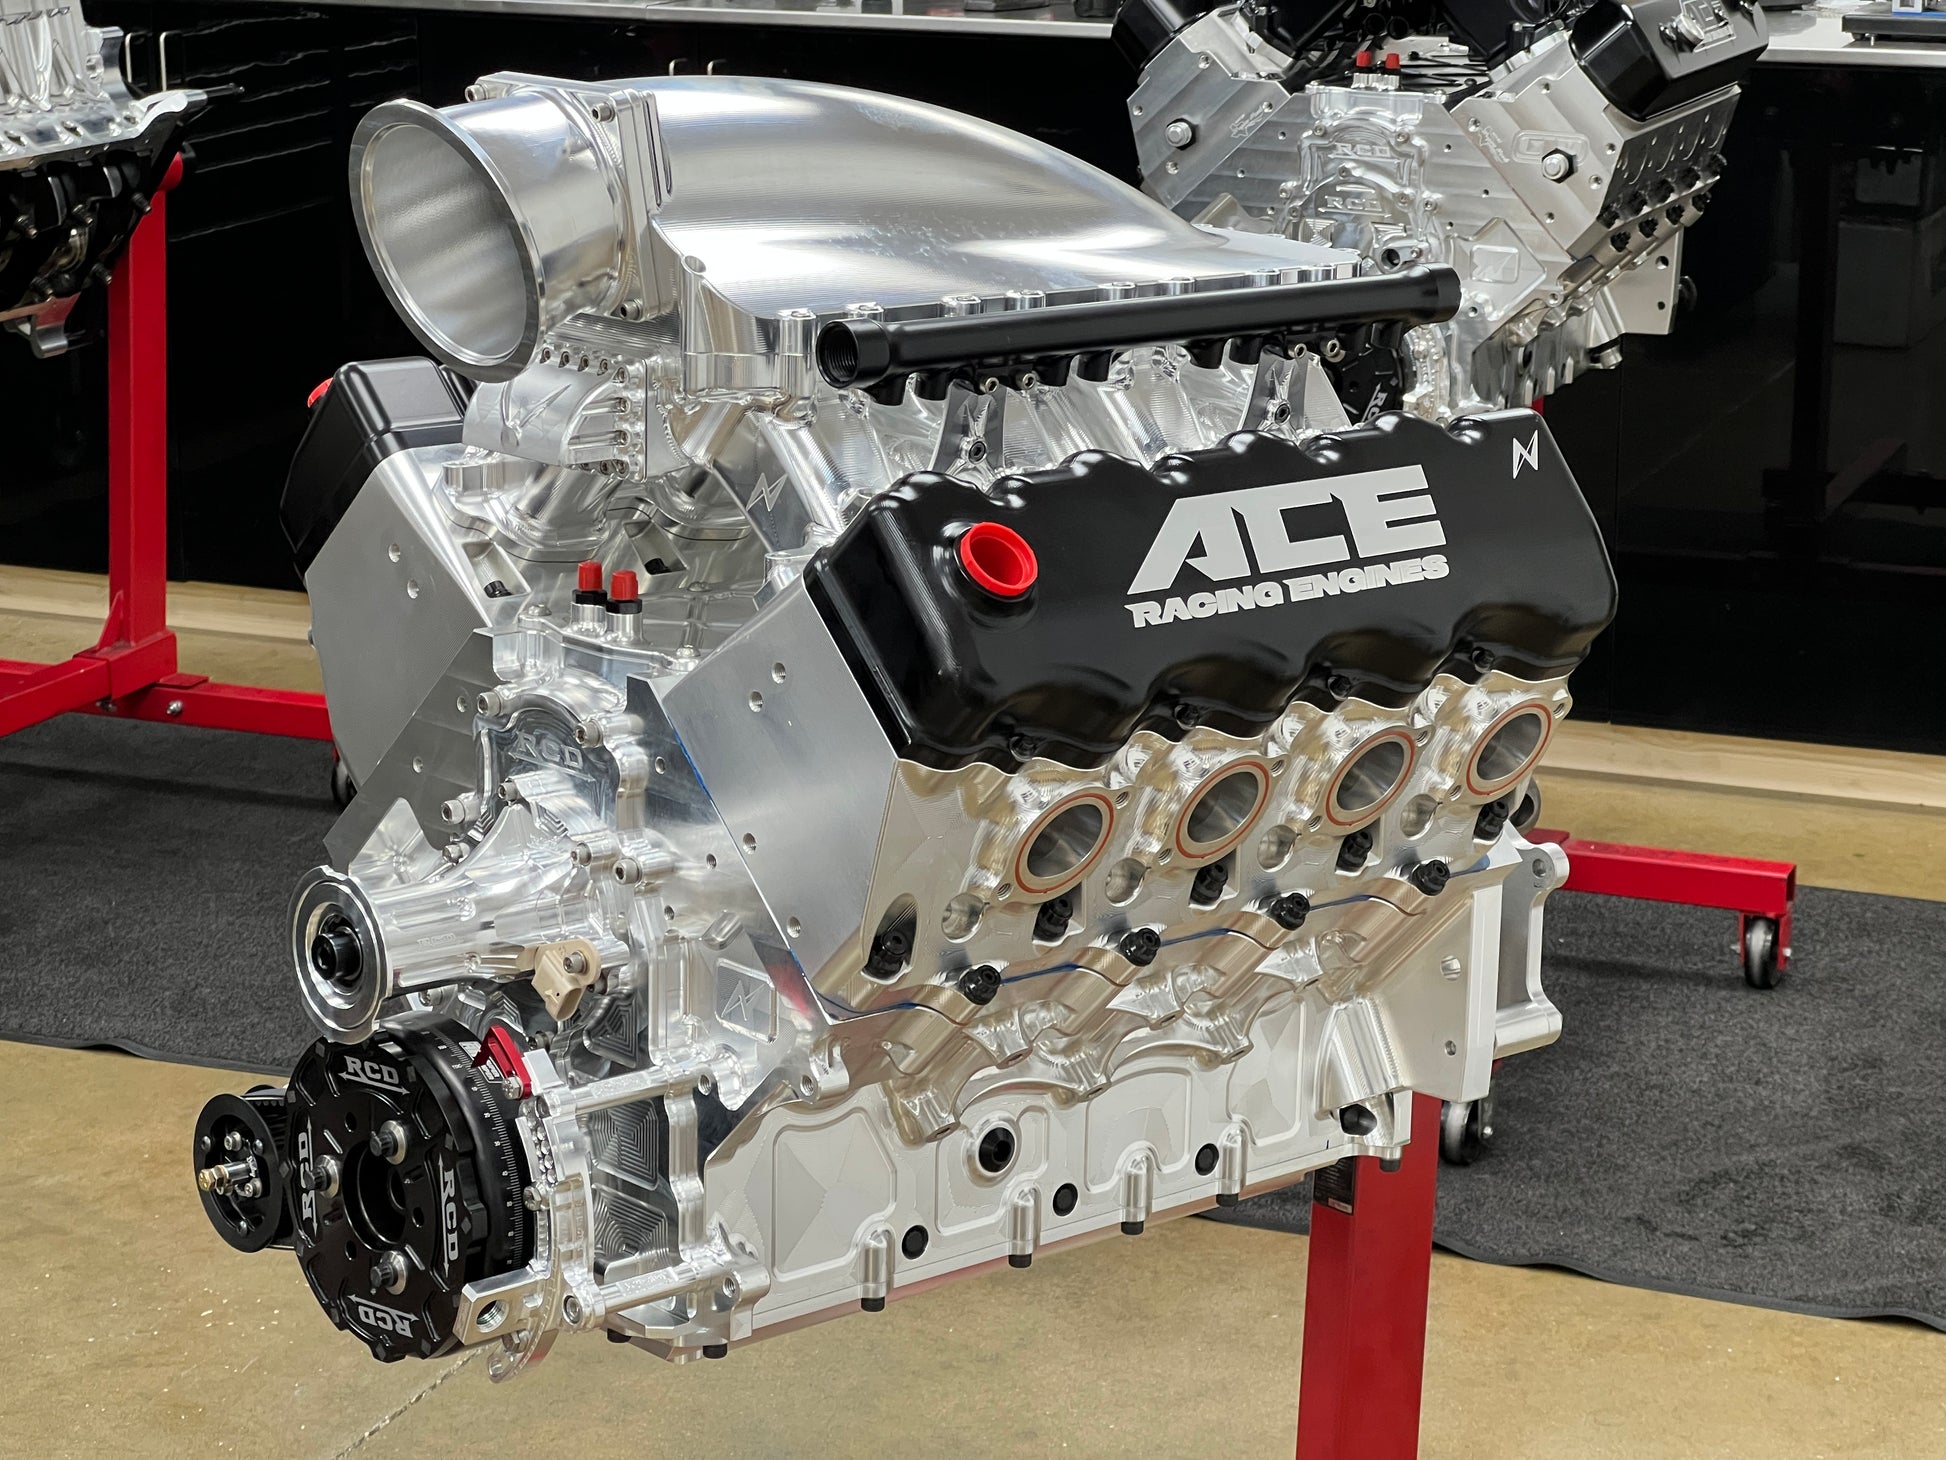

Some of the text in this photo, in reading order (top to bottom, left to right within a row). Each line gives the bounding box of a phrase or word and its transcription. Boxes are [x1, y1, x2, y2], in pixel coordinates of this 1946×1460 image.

[1126, 463, 1447, 595] ACE
[1124, 553, 1450, 629] RACING ENGINES
[515, 729, 584, 770] RCD
[343, 1055, 399, 1085] RCD
[443, 1167, 459, 1261] RCD
[358, 1305, 414, 1339] RCD
